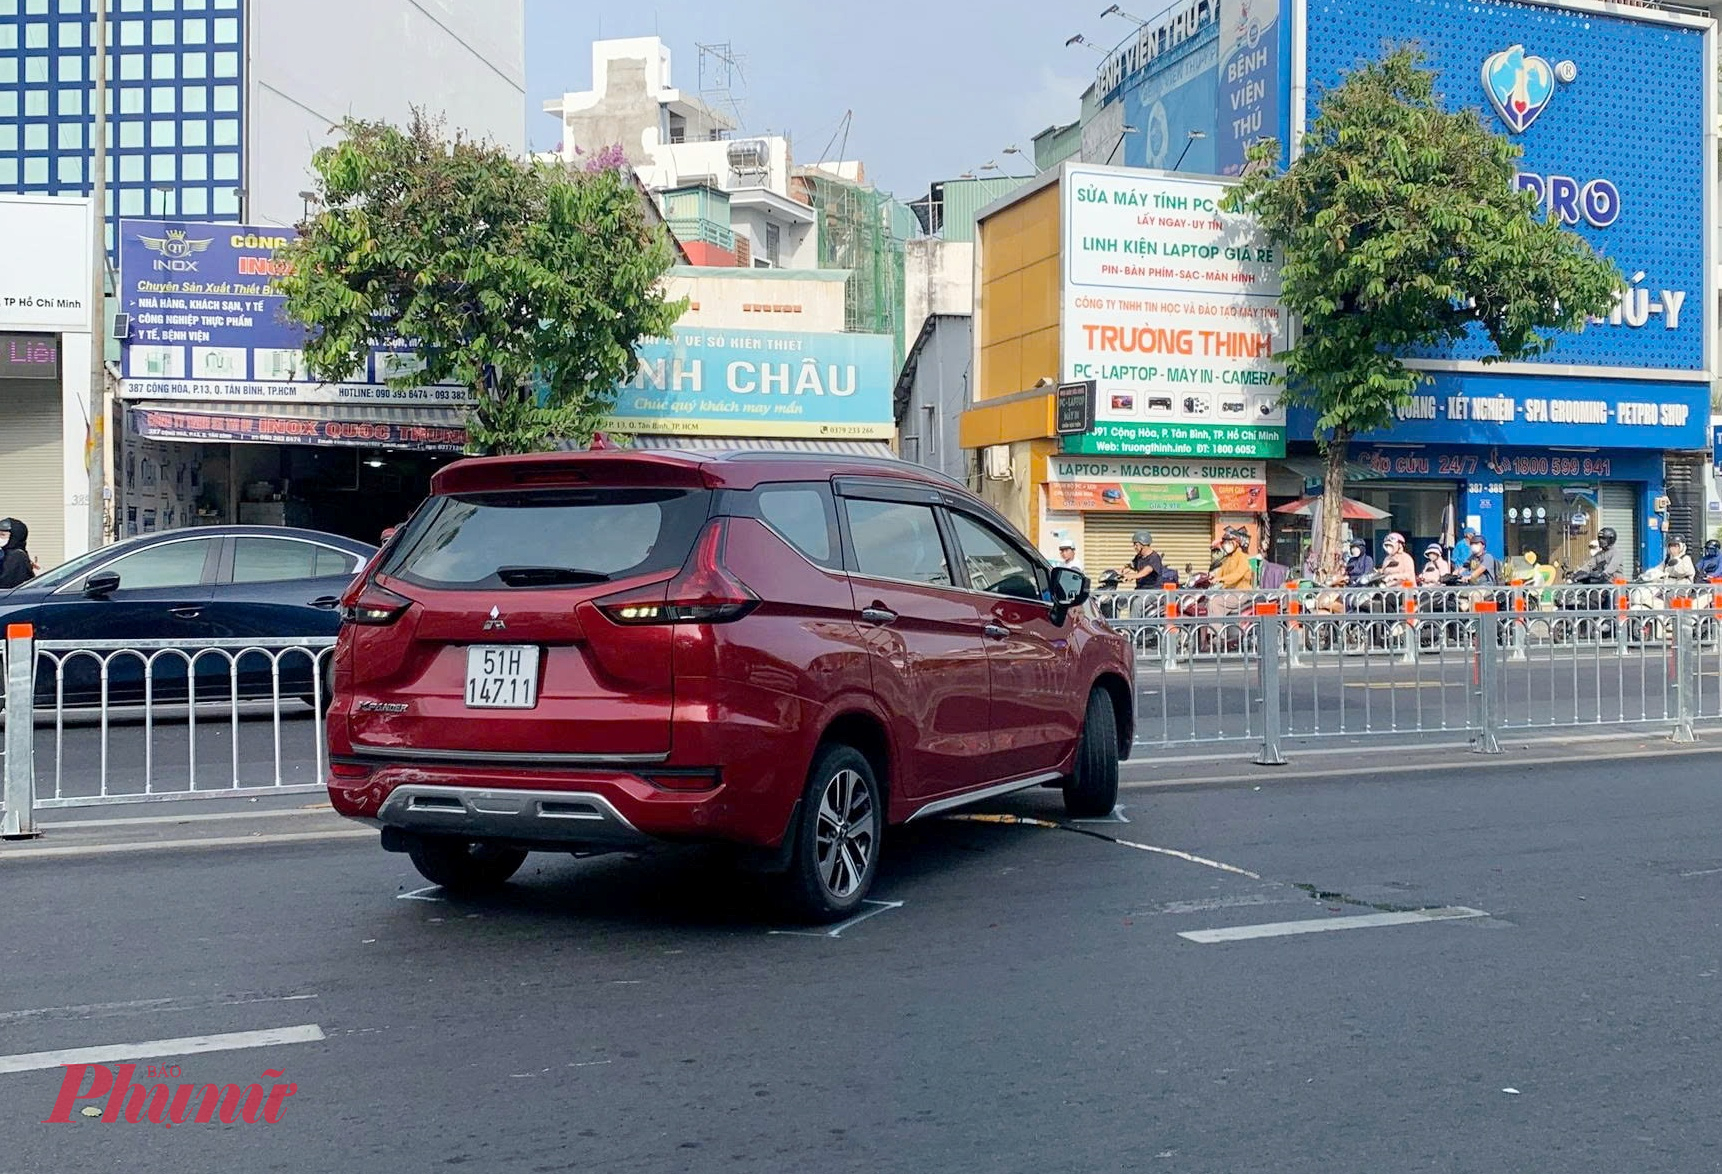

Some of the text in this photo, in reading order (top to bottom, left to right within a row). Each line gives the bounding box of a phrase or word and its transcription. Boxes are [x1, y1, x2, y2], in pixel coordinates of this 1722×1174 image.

[1228, 47, 1267, 84] BỆNH
[1230, 79, 1265, 110] VIỆN
[1232, 105, 1262, 140] THÚ
[1077, 184, 1107, 204] SỬA
[1114, 189, 1148, 207] MÁY
[1153, 191, 1187, 210] TÍNH
[1137, 211, 1155, 226] LẤY
[168, 243, 184, 253] QT
[1083, 237, 1117, 252] LINH
[1124, 237, 1157, 258] KIỆN
[1163, 242, 1219, 259] LAPTOP
[1225, 243, 1251, 261] GIÁ
[153, 259, 199, 272] INOX
[4, 296, 81, 308] TP Hồ Chí Minh
[189, 299, 220, 310] KHÁCH
[1075, 296, 1103, 309] CÔNG
[1106, 300, 1115, 310] TY
[1119, 300, 1142, 311] TNHH
[1145, 301, 1158, 312] TIN
[1161, 303, 1180, 316] HỌC
[138, 313, 164, 324] CÔNG
[1082, 323, 1272, 362] TRƯỜNG THỊNH
[726, 357, 857, 397] CHÂU
[1074, 364, 1092, 378] PC
[1101, 365, 1158, 380] LAPTOP
[1201, 369, 1212, 384] IN
[128, 383, 143, 393] 387
[146, 382, 169, 394] CỘNG
[225, 384, 241, 395] TÂN
[339, 388, 374, 398] HOTLINE:
[376, 388, 390, 398] 090
[435, 390, 449, 399] 093
[634, 399, 666, 411] Chúc
[671, 400, 695, 414] quý
[700, 401, 739, 413] khách
[743, 405, 771, 416] may
[1525, 399, 1548, 422] SPA
[1550, 400, 1607, 424] GROOMING
[1617, 402, 1658, 425] PETPRO
[1659, 404, 1688, 427] SHOP
[259, 418, 318, 436] INOX
[325, 421, 390, 440] QUỐC
[1111, 427, 1136, 439] Cộng
[1171, 428, 1187, 438] Tân
[1227, 428, 1239, 440] Hồ
[1241, 430, 1256, 440] Chí
[1258, 430, 1279, 440] Minh
[1095, 441, 1119, 452] Web:
[1213, 444, 1233, 454] 1800
[1235, 444, 1256, 454] 6052
[1058, 463, 1256, 479] LAPTOP MACBOOK SURFACE
[1439, 455, 1479, 475] 24/7
[1513, 456, 1548, 475] 1800
[1551, 458, 1580, 476] 599
[1583, 458, 1611, 477] 941
[483, 650, 521, 675] 51H
[469, 678, 530, 704] 147.11
